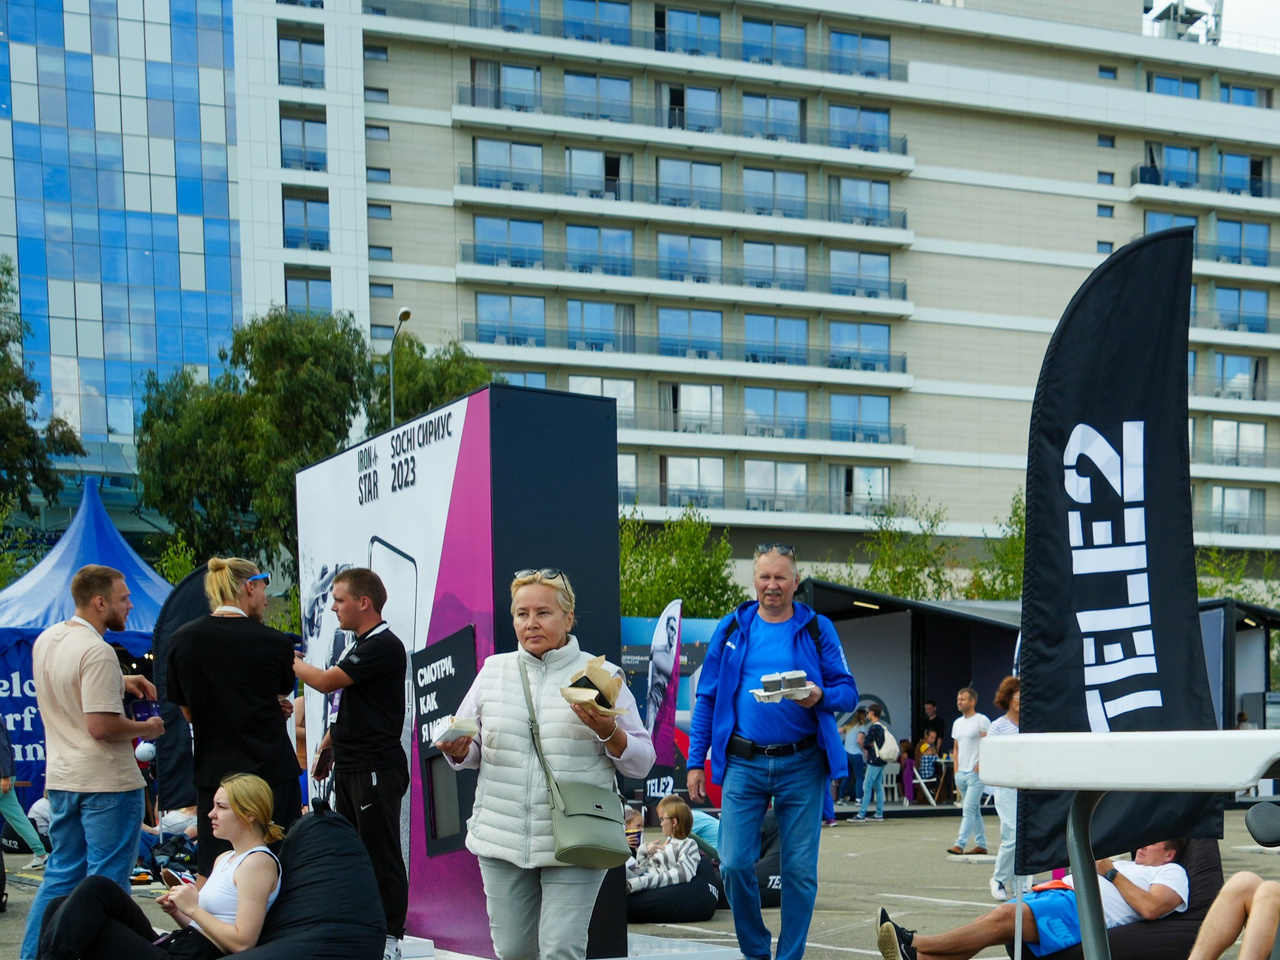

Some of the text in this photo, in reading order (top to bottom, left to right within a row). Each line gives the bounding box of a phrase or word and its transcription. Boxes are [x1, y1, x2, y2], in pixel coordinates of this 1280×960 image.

[391, 411, 453, 459] SOCHI СИРИУС
[357, 445, 373, 474] IRON
[391, 455, 416, 492] 2023
[358, 469, 379, 506] STAR
[1063, 420, 1163, 732] TELE2
[417, 655, 455, 688] СМОТРИ,
[420, 691, 439, 715] КАК
[646, 775, 674, 798] TELE2
